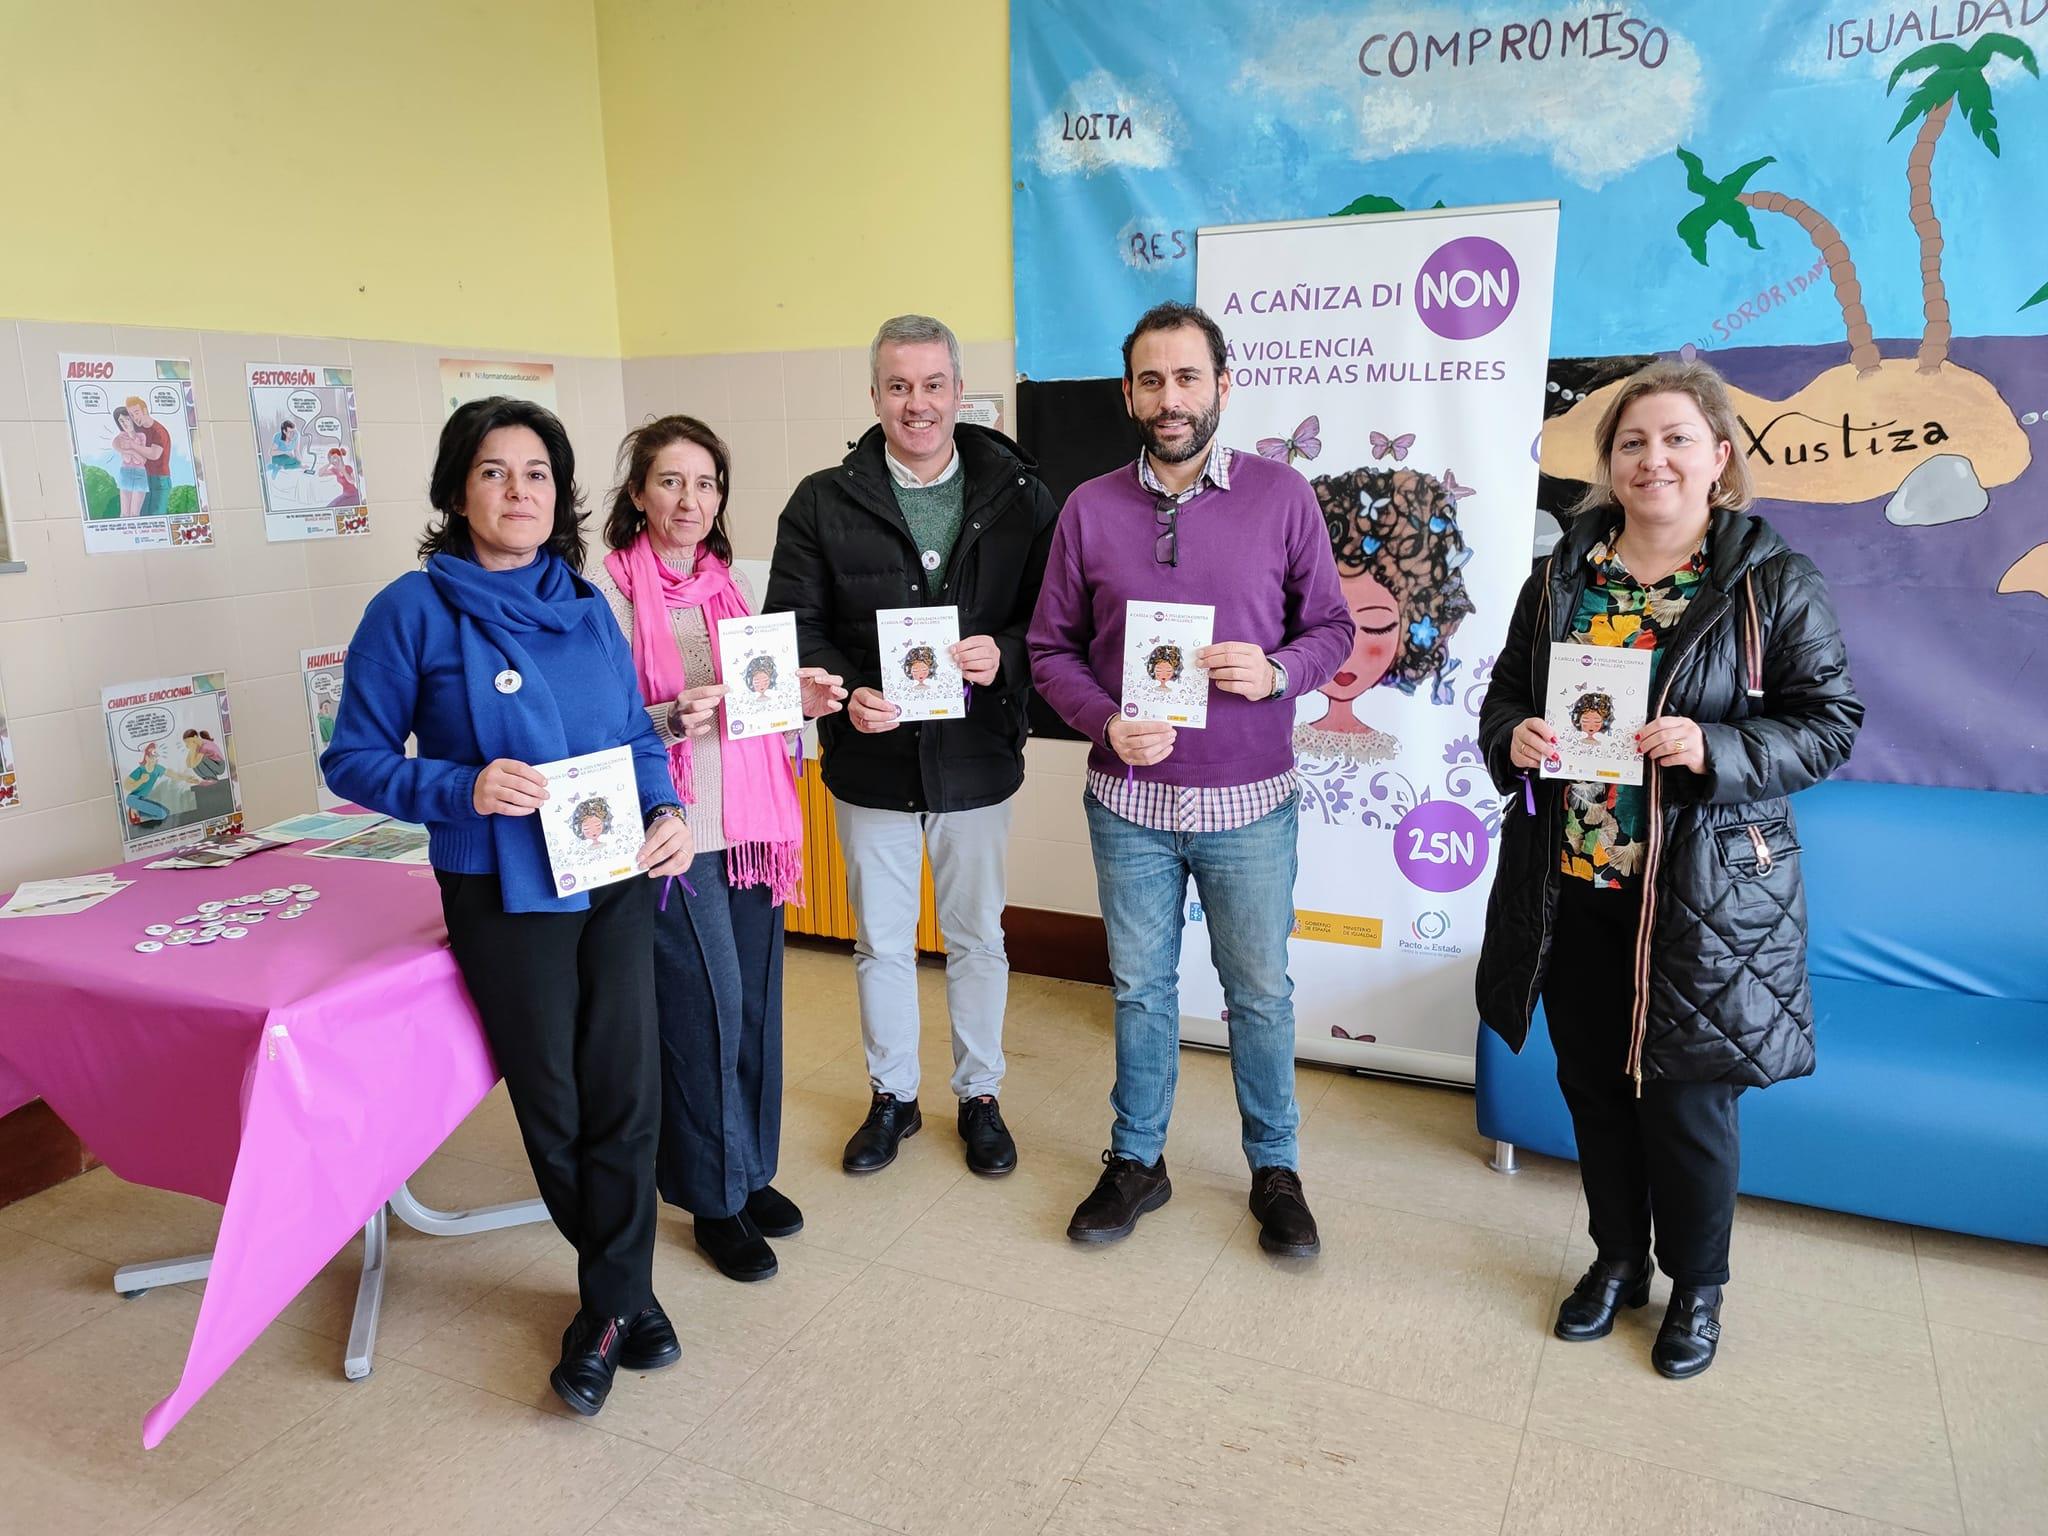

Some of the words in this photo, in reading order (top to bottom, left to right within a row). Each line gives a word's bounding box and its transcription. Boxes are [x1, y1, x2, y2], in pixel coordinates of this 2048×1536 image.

[1358, 12, 1669, 77] COMPROMISO
[1062, 112, 1132, 141] LOITA
[1223, 292, 1243, 315] A
[1250, 283, 1362, 314] CAÑIZA
[1372, 283, 1402, 307] DI
[1421, 268, 1510, 310] NON
[1242, 337, 1374, 361] VIOLENCIA
[67, 361, 114, 379] ABUSO
[252, 369, 316, 386] SEXTORSIÓN
[1230, 364, 1321, 388] ONTRA
[1326, 364, 1358, 384] AS
[1366, 361, 1506, 383] MULLERES
[1736, 412, 1949, 465] Xustiza
[108, 695, 147, 709] CHANTAXE
[149, 686, 193, 702] EMOCIONAL
[1408, 827, 1475, 866] 25N
[1343, 925, 1372, 933] MINISTERIO
[1351, 931, 1378, 939] IGUALDAD
[1399, 940, 1422, 950] Pacto
[1432, 943, 1462, 954] Estado
